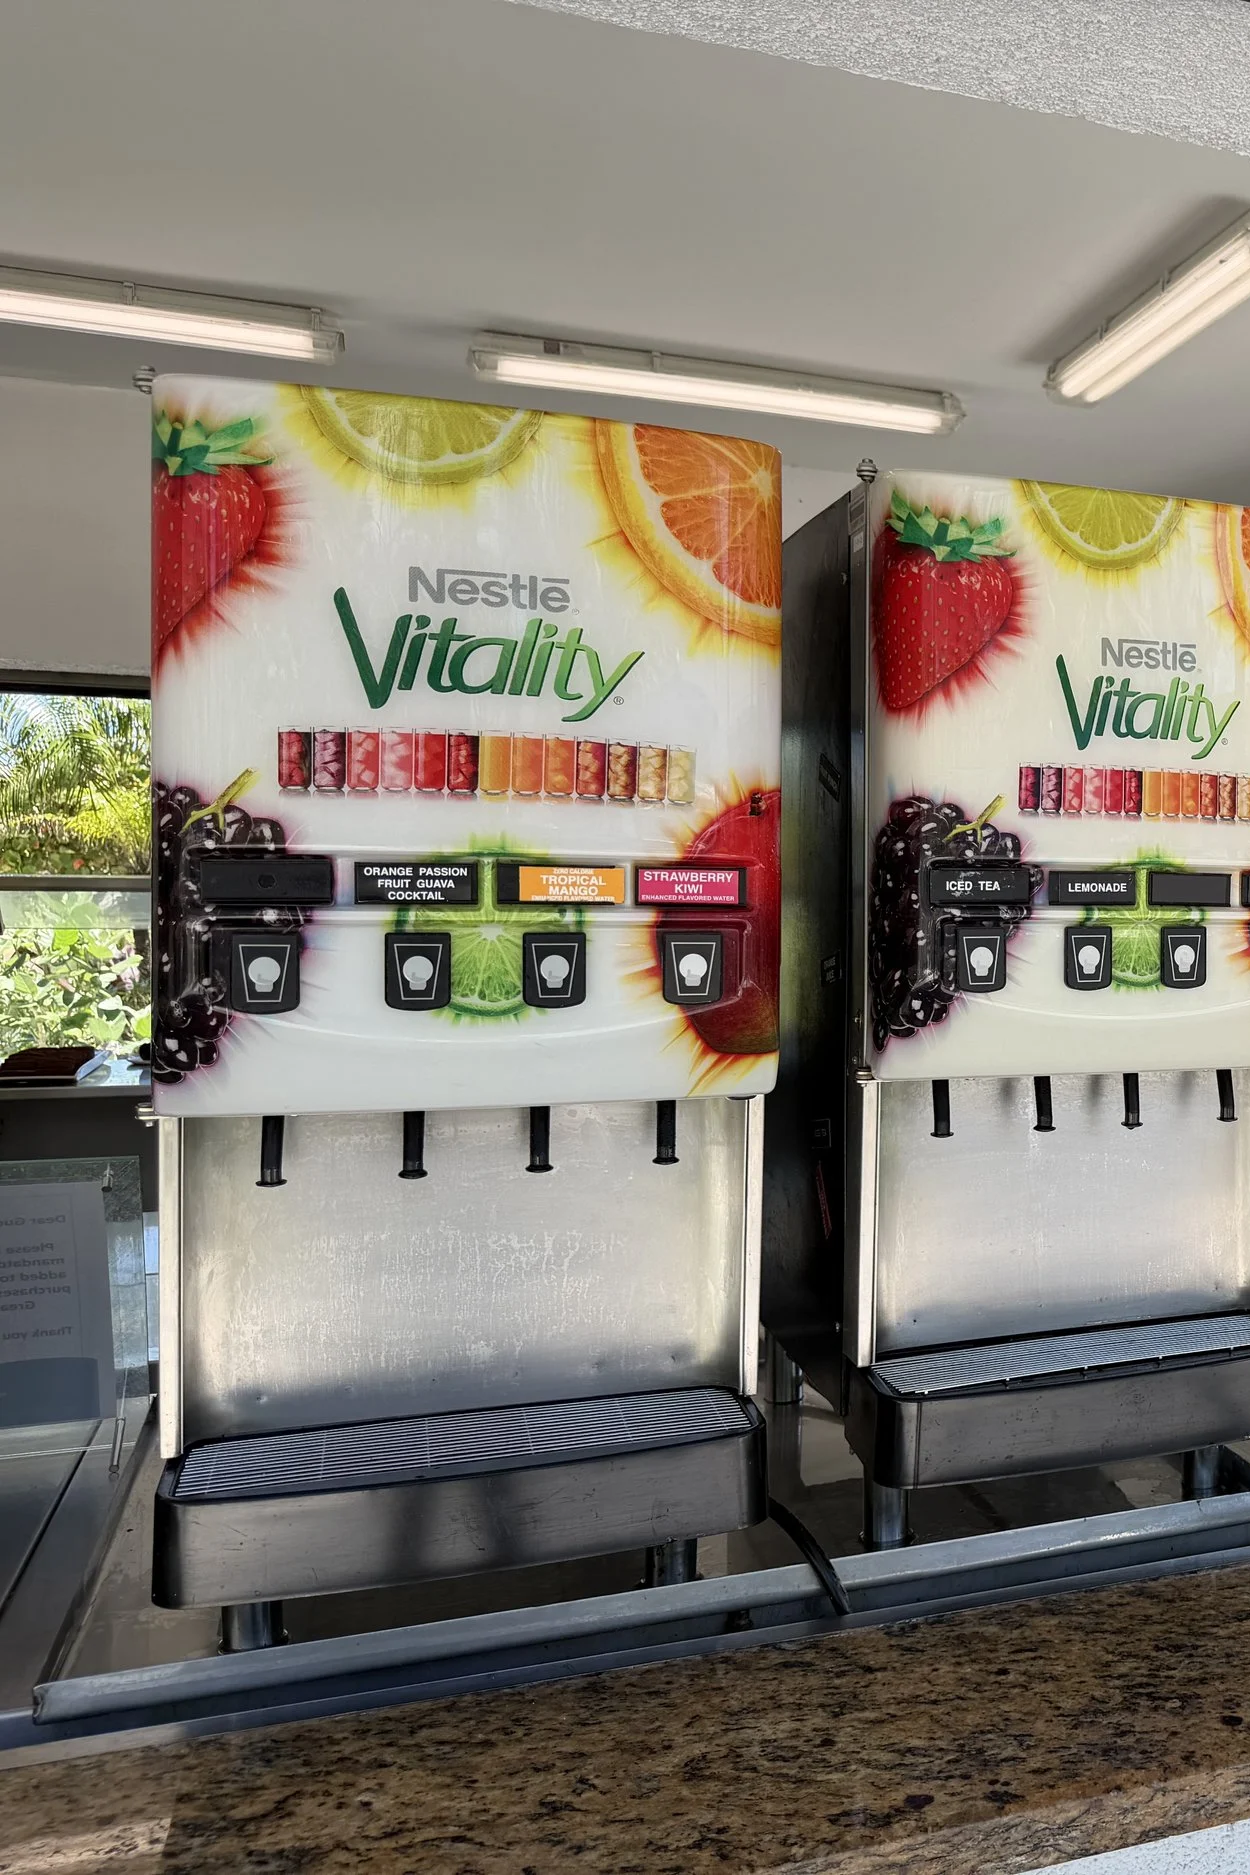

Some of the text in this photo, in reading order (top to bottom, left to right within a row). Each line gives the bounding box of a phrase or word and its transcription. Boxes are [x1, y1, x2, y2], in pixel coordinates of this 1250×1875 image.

[333, 586, 645, 722] Vitality
[1056, 654, 1241, 760] Vitality
[363, 867, 468, 877] ORANGE PASSION
[643, 871, 734, 883] STRAWBERRY
[377, 879, 455, 888] FRUIT GUAVA
[540, 874, 607, 886] TROPICAL
[945, 880, 1001, 891] ICED TEA
[548, 886, 599, 896] MANGO
[674, 883, 703, 894] KIWI
[1068, 882, 1127, 893] LEMONADE
[387, 891, 445, 900] COCKTAIL
[678, 894, 712, 902] FLAVORED
